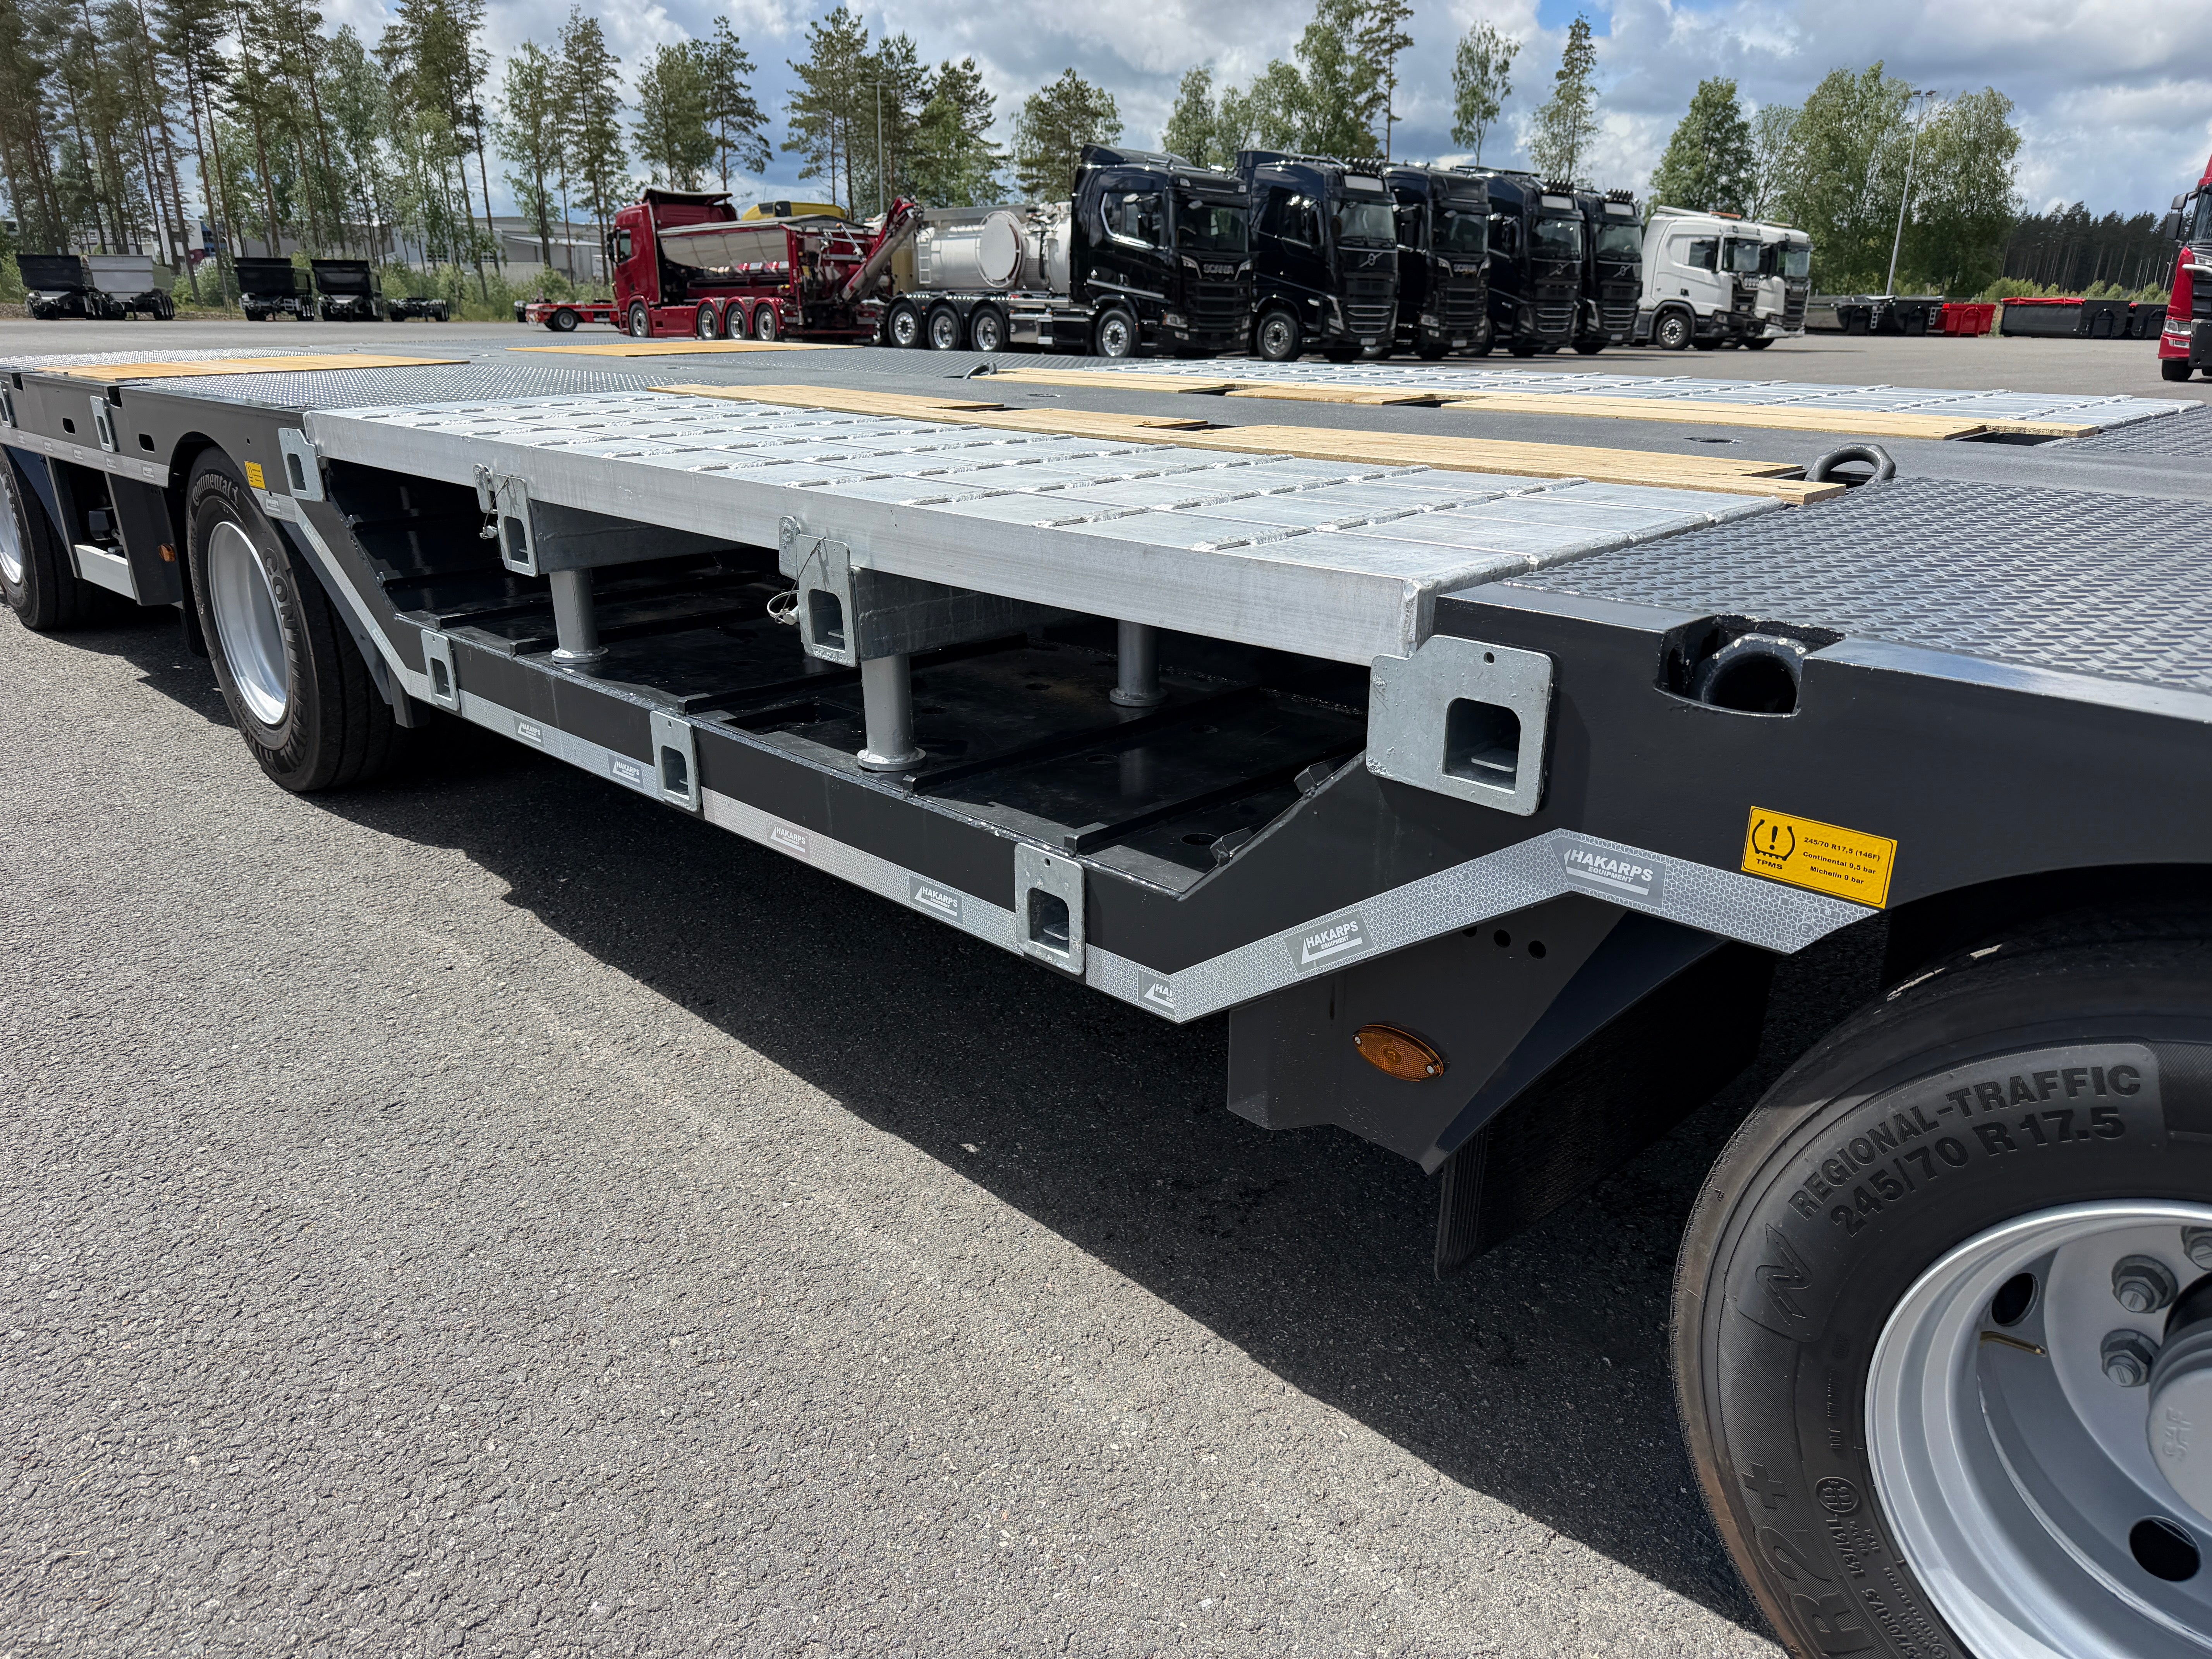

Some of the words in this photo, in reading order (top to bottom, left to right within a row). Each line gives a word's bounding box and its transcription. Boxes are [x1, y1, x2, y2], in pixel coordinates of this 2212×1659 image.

[192, 474, 232, 506] Continental
[521, 722, 541, 735] HAKARPS
[617, 761, 639, 776] HAKARPS
[776, 826, 805, 844] HAKARPS
[1804, 837, 1829, 848] 245/70
[1831, 844, 1853, 854] R17,5
[1855, 850, 1880, 862] (146F)
[1570, 849, 1654, 881] HAKARPS
[1756, 858, 1783, 870] TPMS
[1803, 851, 1847, 867] Continental
[1863, 865, 1876, 874] bar
[1437, 877, 1461, 890] ORAFOL
[1588, 866, 1633, 883] EQUIPMENT
[1810, 866, 1842, 879] Michelin
[1851, 876, 1864, 884] bar
[922, 886, 958, 907] HAKARPS
[1788, 900, 1824, 916] ORAFOL
[1306, 921, 1358, 948] HAKARPS
[1780, 934, 1793, 943] 104
[1801, 925, 1813, 936] E4
[1321, 935, 1349, 949] EQUIPMENT
[1788, 1064, 2142, 1221] REGIONAL-TRAFFIC
[1830, 1136, 1969, 1238] 245/70
[1826, 1514, 1865, 1578] 143/141L
